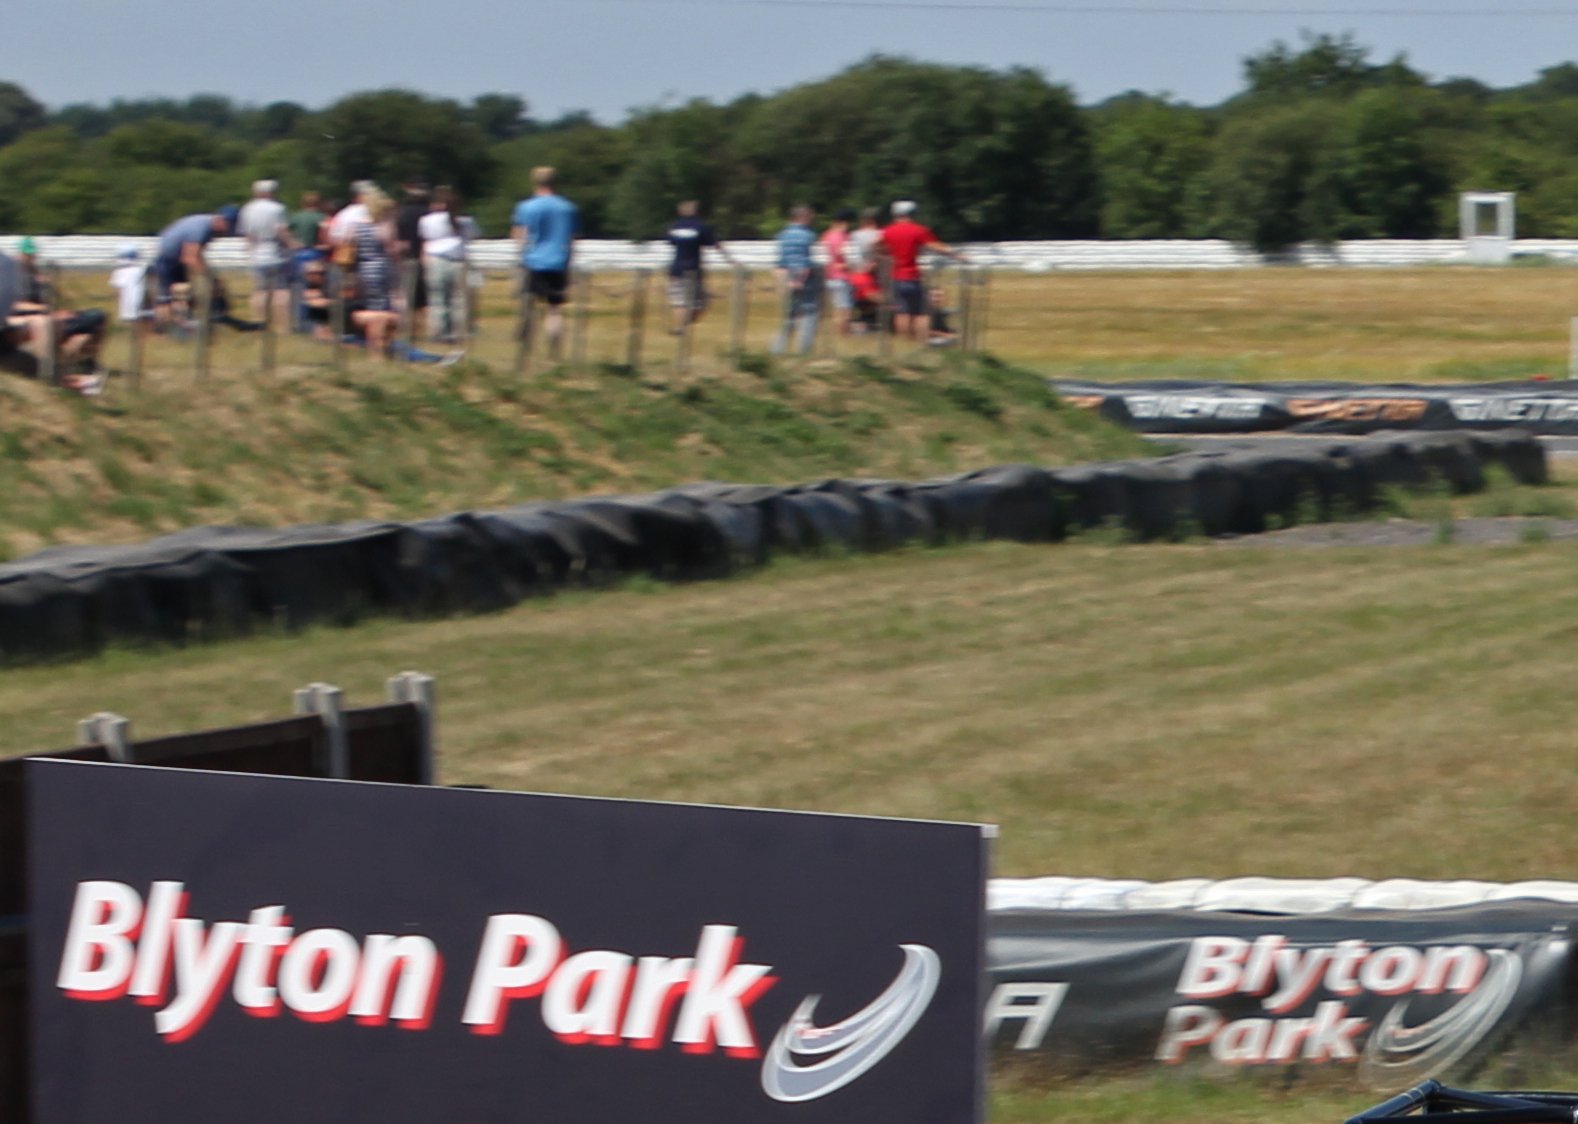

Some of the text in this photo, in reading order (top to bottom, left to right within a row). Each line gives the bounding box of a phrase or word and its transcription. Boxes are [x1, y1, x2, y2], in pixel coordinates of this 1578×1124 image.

[56, 880, 779, 1059] Blyton Park
[1175, 935, 1491, 1014] Blyton
[1155, 1001, 1369, 1066] Park
